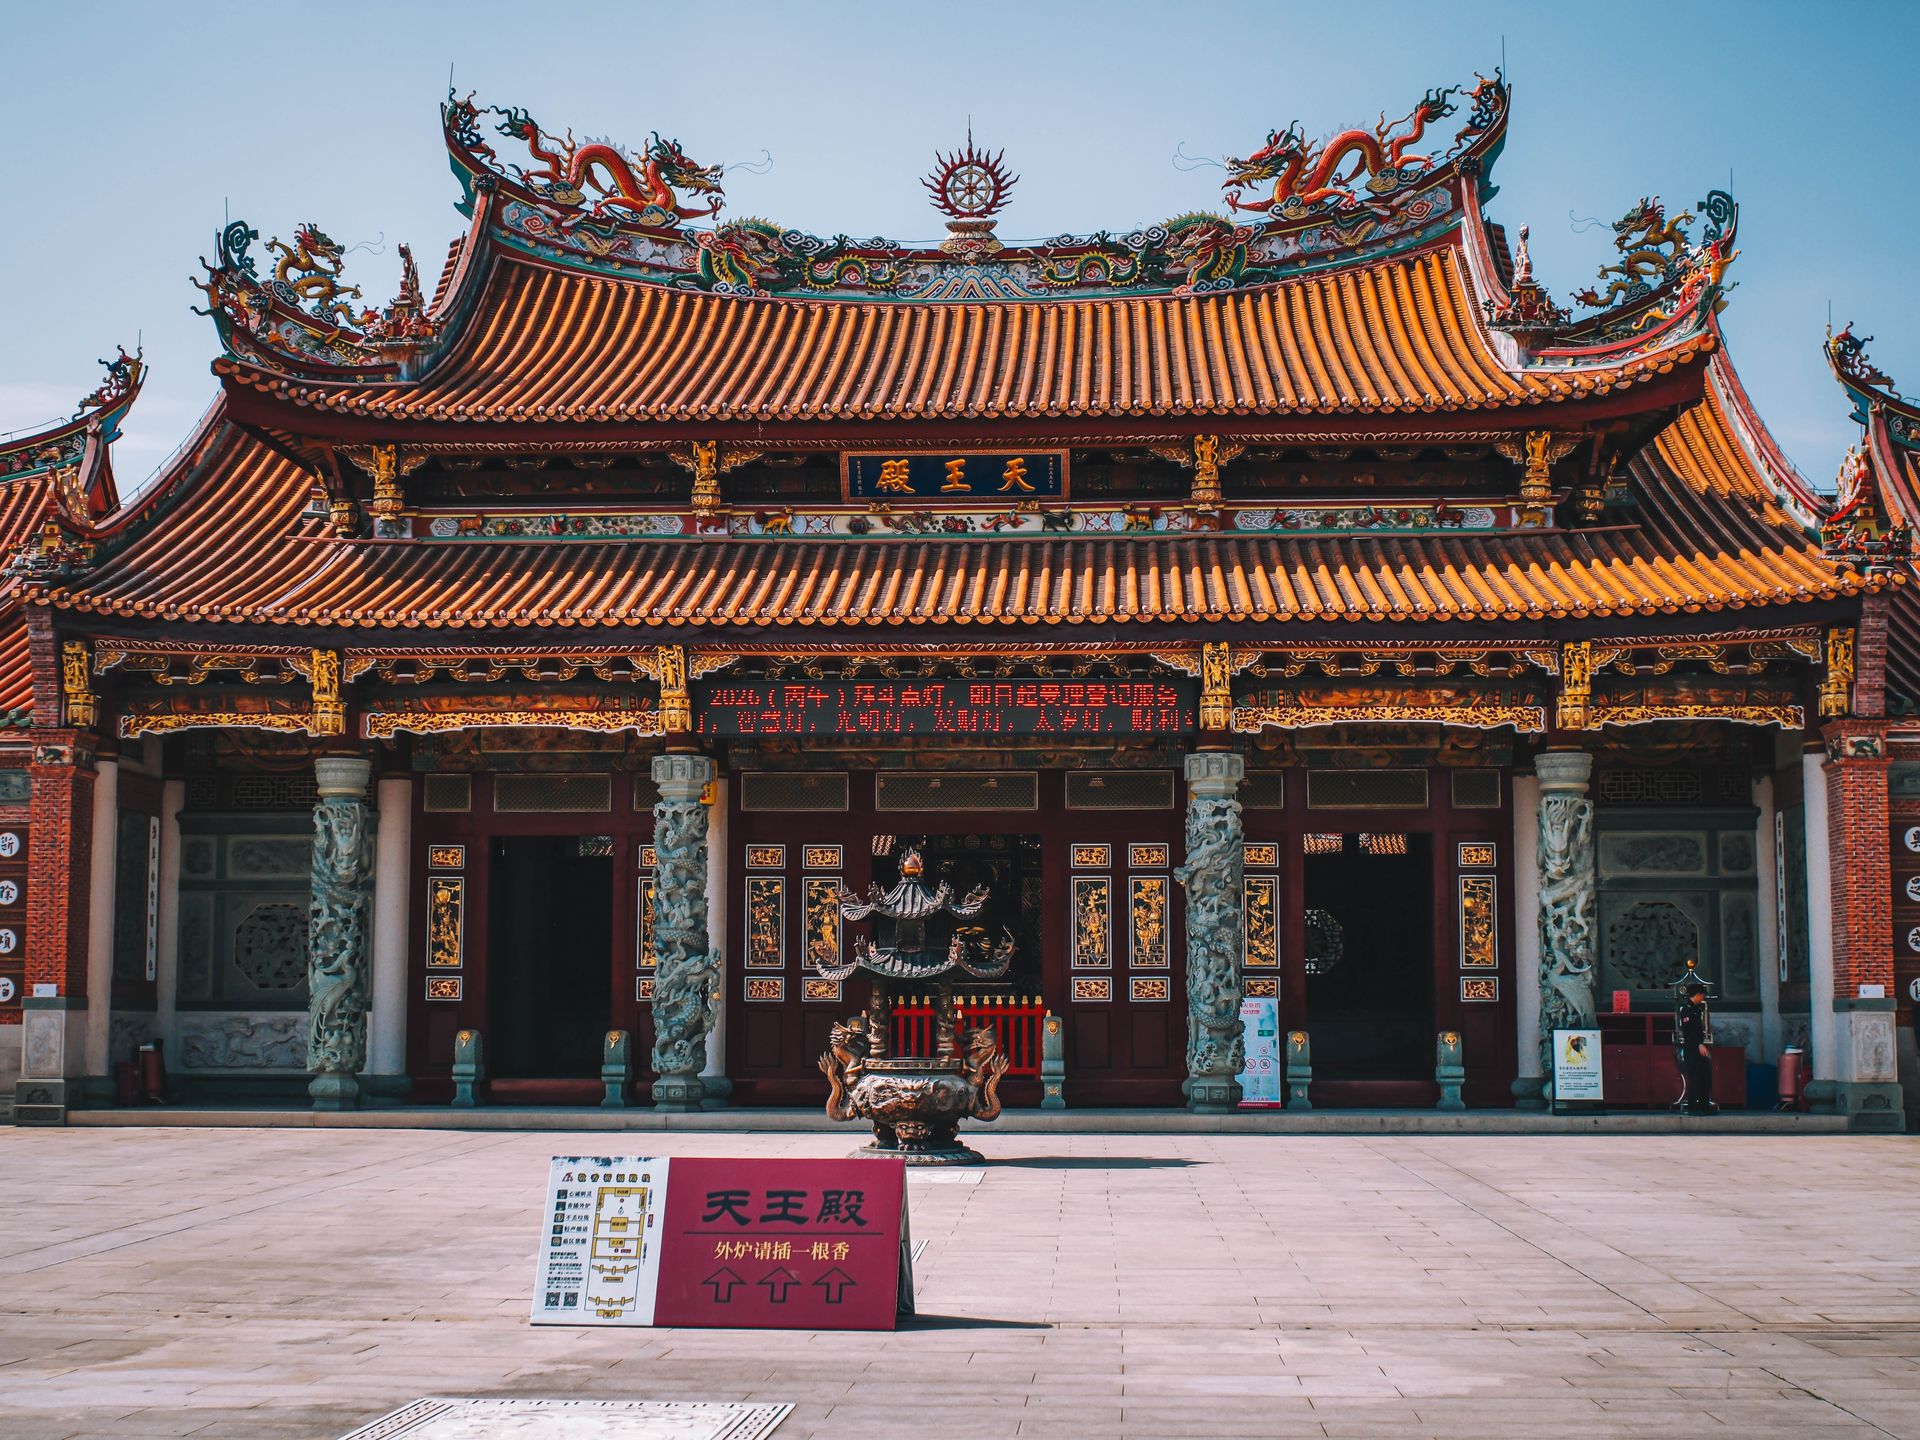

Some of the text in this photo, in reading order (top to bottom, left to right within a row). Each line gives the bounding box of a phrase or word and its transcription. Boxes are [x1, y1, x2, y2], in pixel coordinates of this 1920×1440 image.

[876, 458, 1036, 493] 天王殿
[701, 1189, 868, 1227] 天王殿
[714, 1240, 851, 1262] 外炉请插一根香
